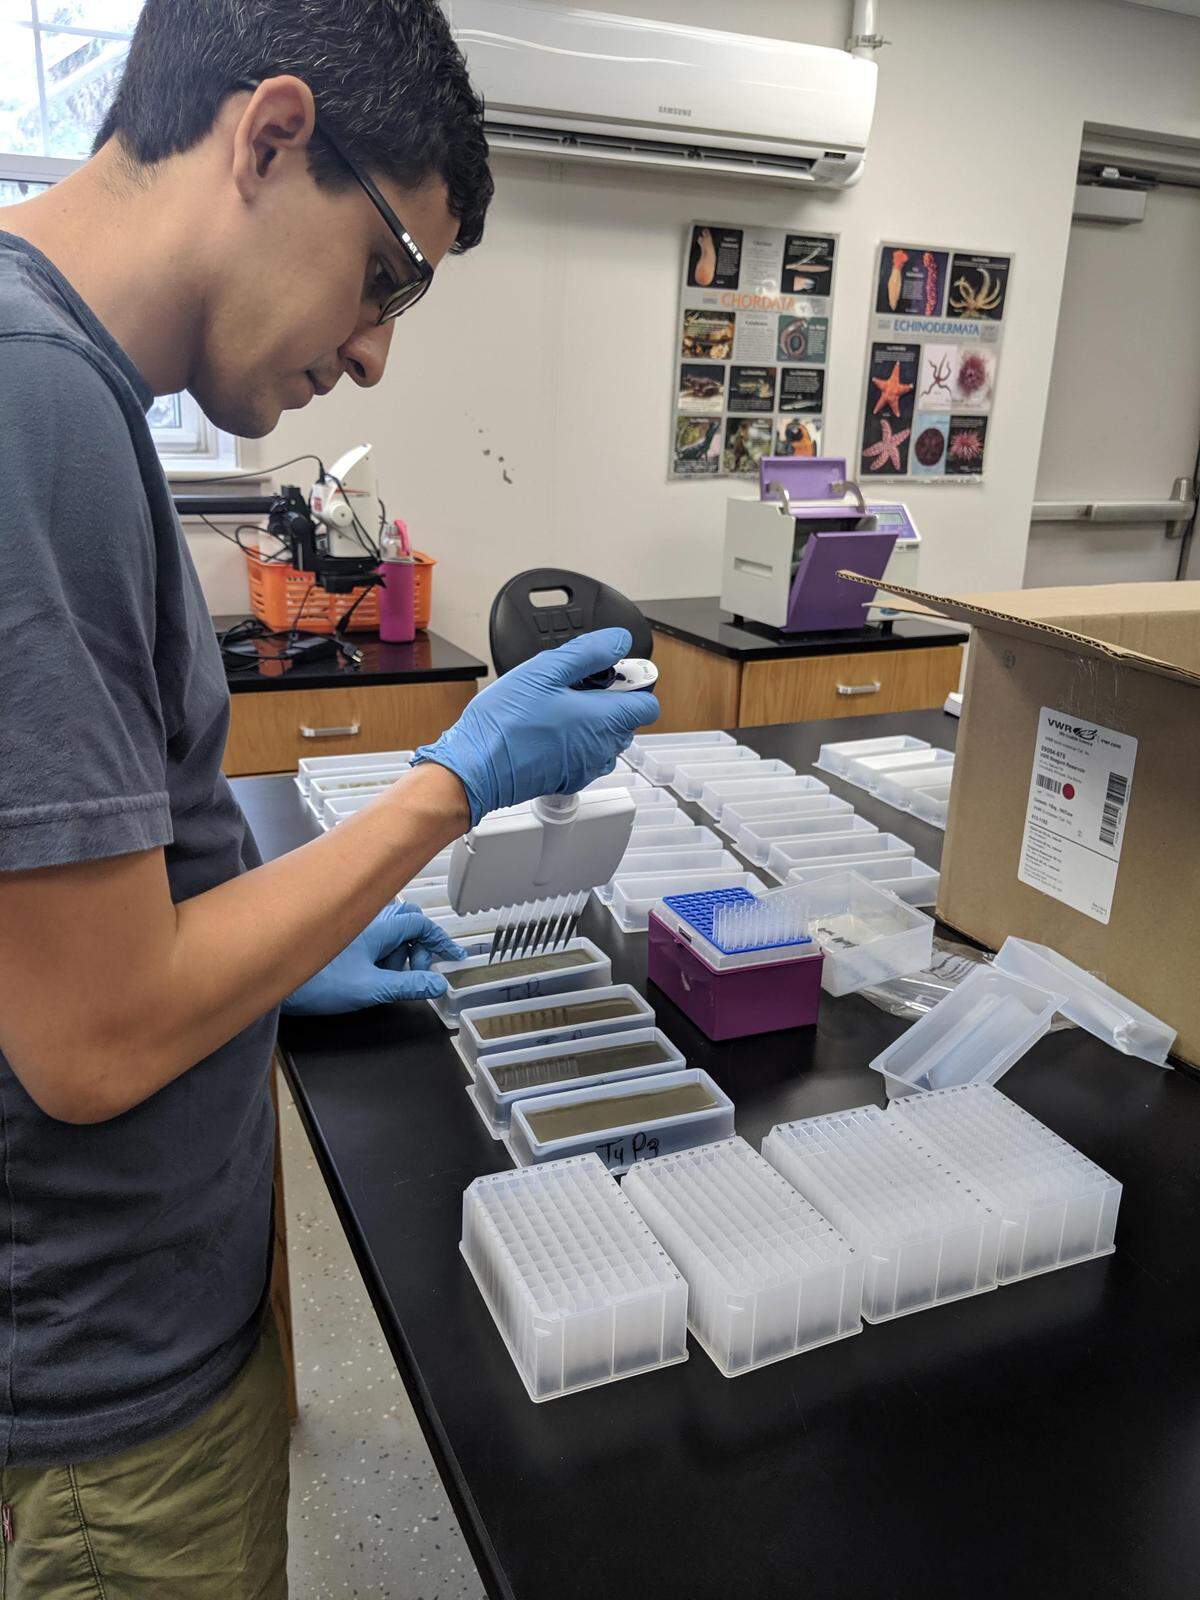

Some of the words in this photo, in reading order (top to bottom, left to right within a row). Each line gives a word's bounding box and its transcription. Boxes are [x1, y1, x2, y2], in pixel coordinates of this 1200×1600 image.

[658, 106, 692, 117] SAMSUNG
[720, 291, 796, 313] CHORDATA
[893, 319, 980, 336] ECHINODERMATA
[1047, 718, 1073, 734] VWR
